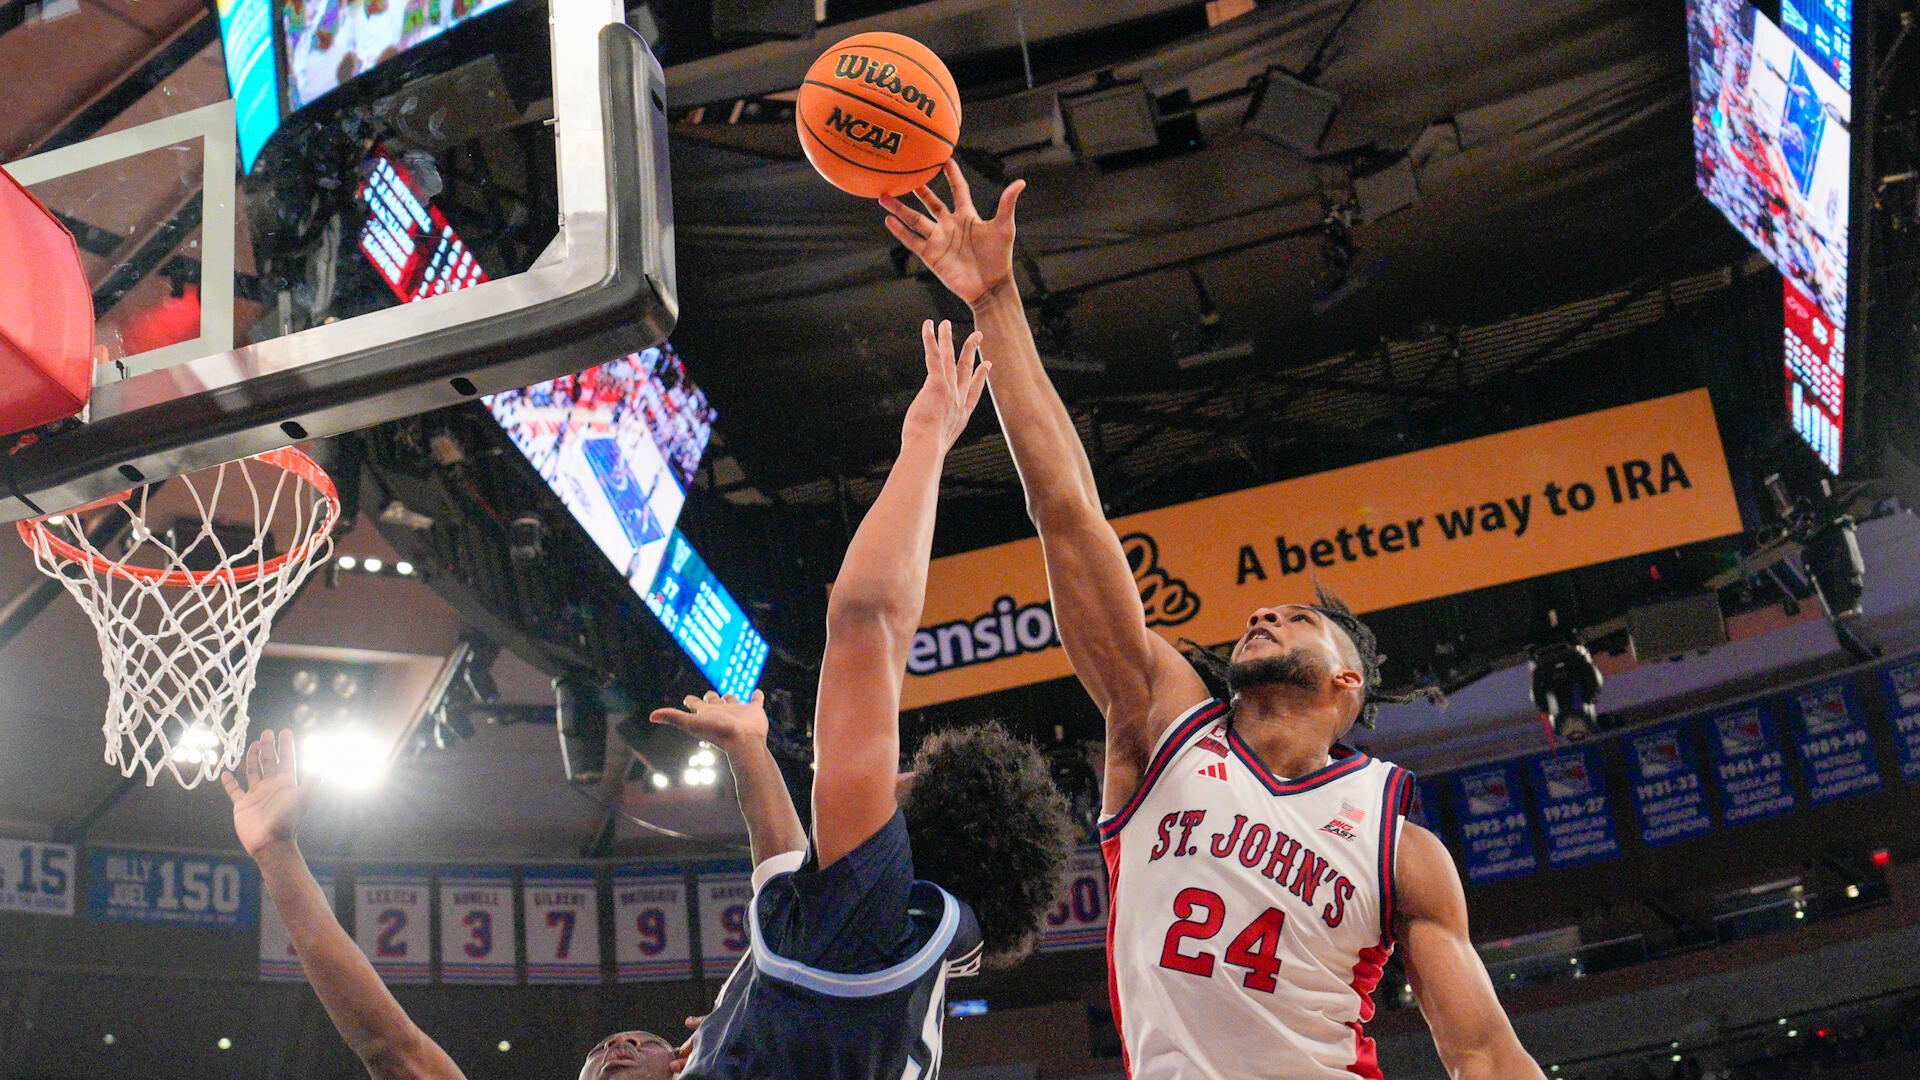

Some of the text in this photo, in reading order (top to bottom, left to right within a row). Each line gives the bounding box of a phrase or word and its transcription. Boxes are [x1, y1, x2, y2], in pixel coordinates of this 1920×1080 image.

[834, 54, 936, 119] Wilson
[825, 106, 903, 154] NCAA
[1236, 452, 1692, 585] A better way to IRA
[907, 595, 1061, 677] ensio
[1324, 824, 1357, 840] EAST
[1330, 819, 1354, 831] BIG
[17, 847, 69, 897] 15
[157, 859, 241, 913] 150
[1149, 810, 1356, 928] ST. JOHN'S
[107, 882, 150, 908] JOEL
[377, 908, 408, 958] 2
[463, 910, 494, 959] 3
[545, 909, 576, 960] 7
[637, 906, 668, 957] 9
[721, 904, 750, 952] 9
[1160, 887, 1286, 994] 24
